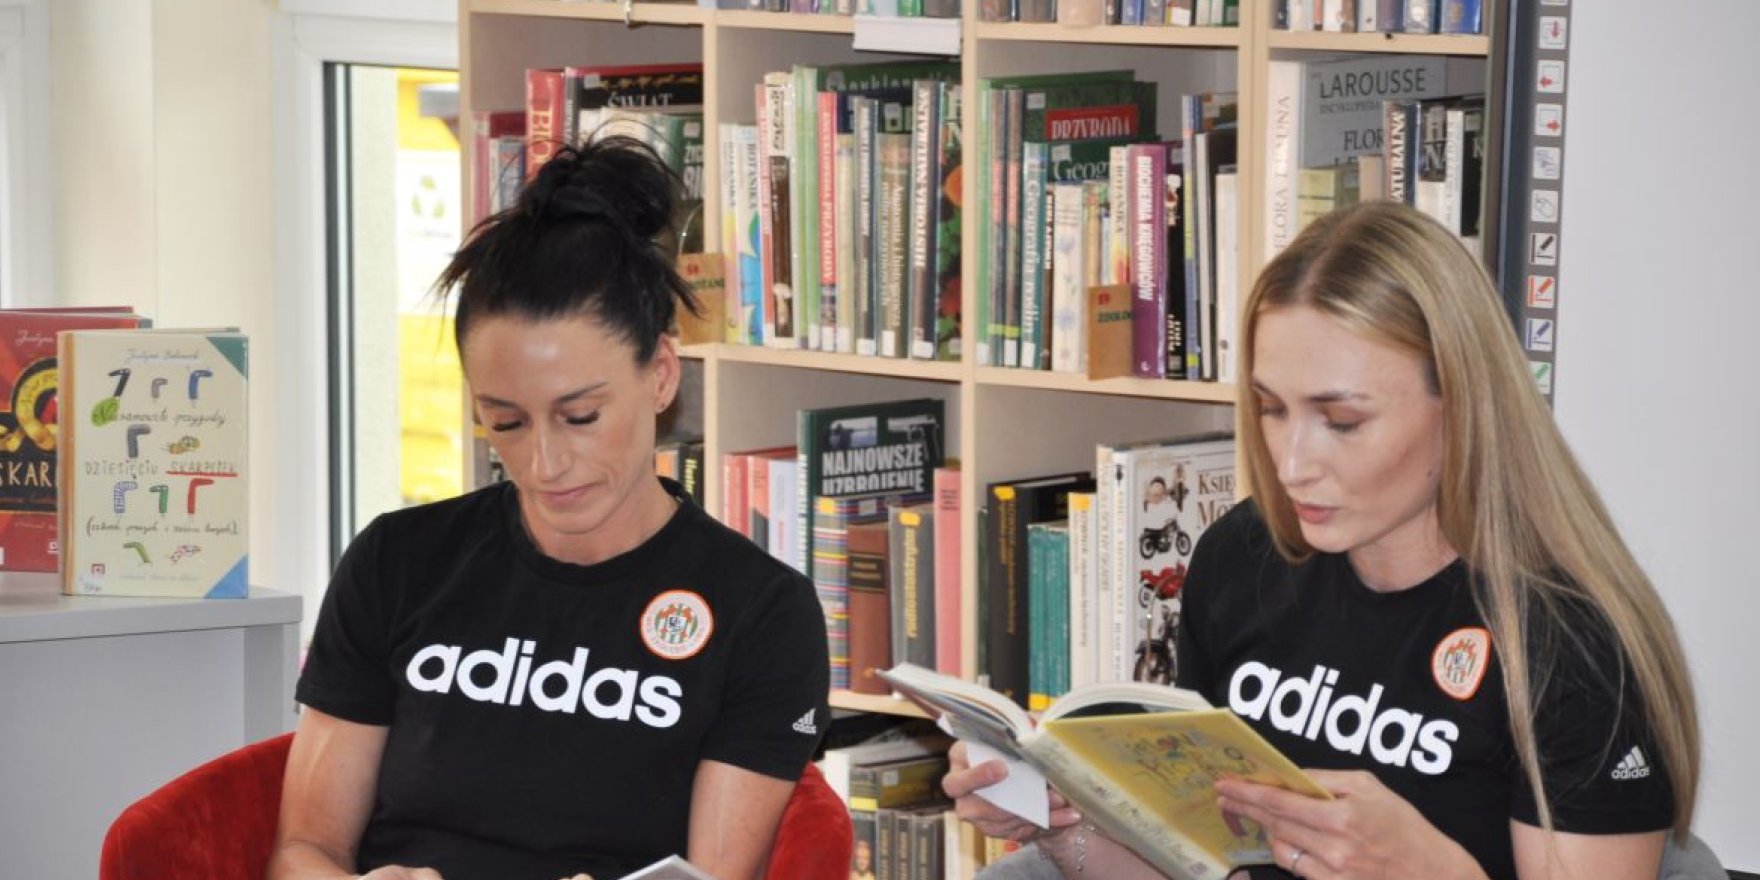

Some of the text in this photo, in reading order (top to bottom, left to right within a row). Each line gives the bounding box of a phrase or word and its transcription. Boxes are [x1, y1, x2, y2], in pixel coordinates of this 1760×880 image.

[1319, 68, 1427, 98] LAROUSSE
[915, 88, 929, 267] HISTORIA NATURALNA
[1272, 189, 1288, 249] FLORA
[820, 201, 834, 279] PRZYRODY
[1023, 179, 1040, 334] Geografia roślin
[1135, 156, 1155, 301] BIOCHEMIA KRĘGOWCÓW
[822, 444, 925, 476] NAJNOWSZE
[405, 637, 683, 728] adidas
[1228, 660, 1460, 775] adidas
[1611, 766, 1651, 780] adidas
